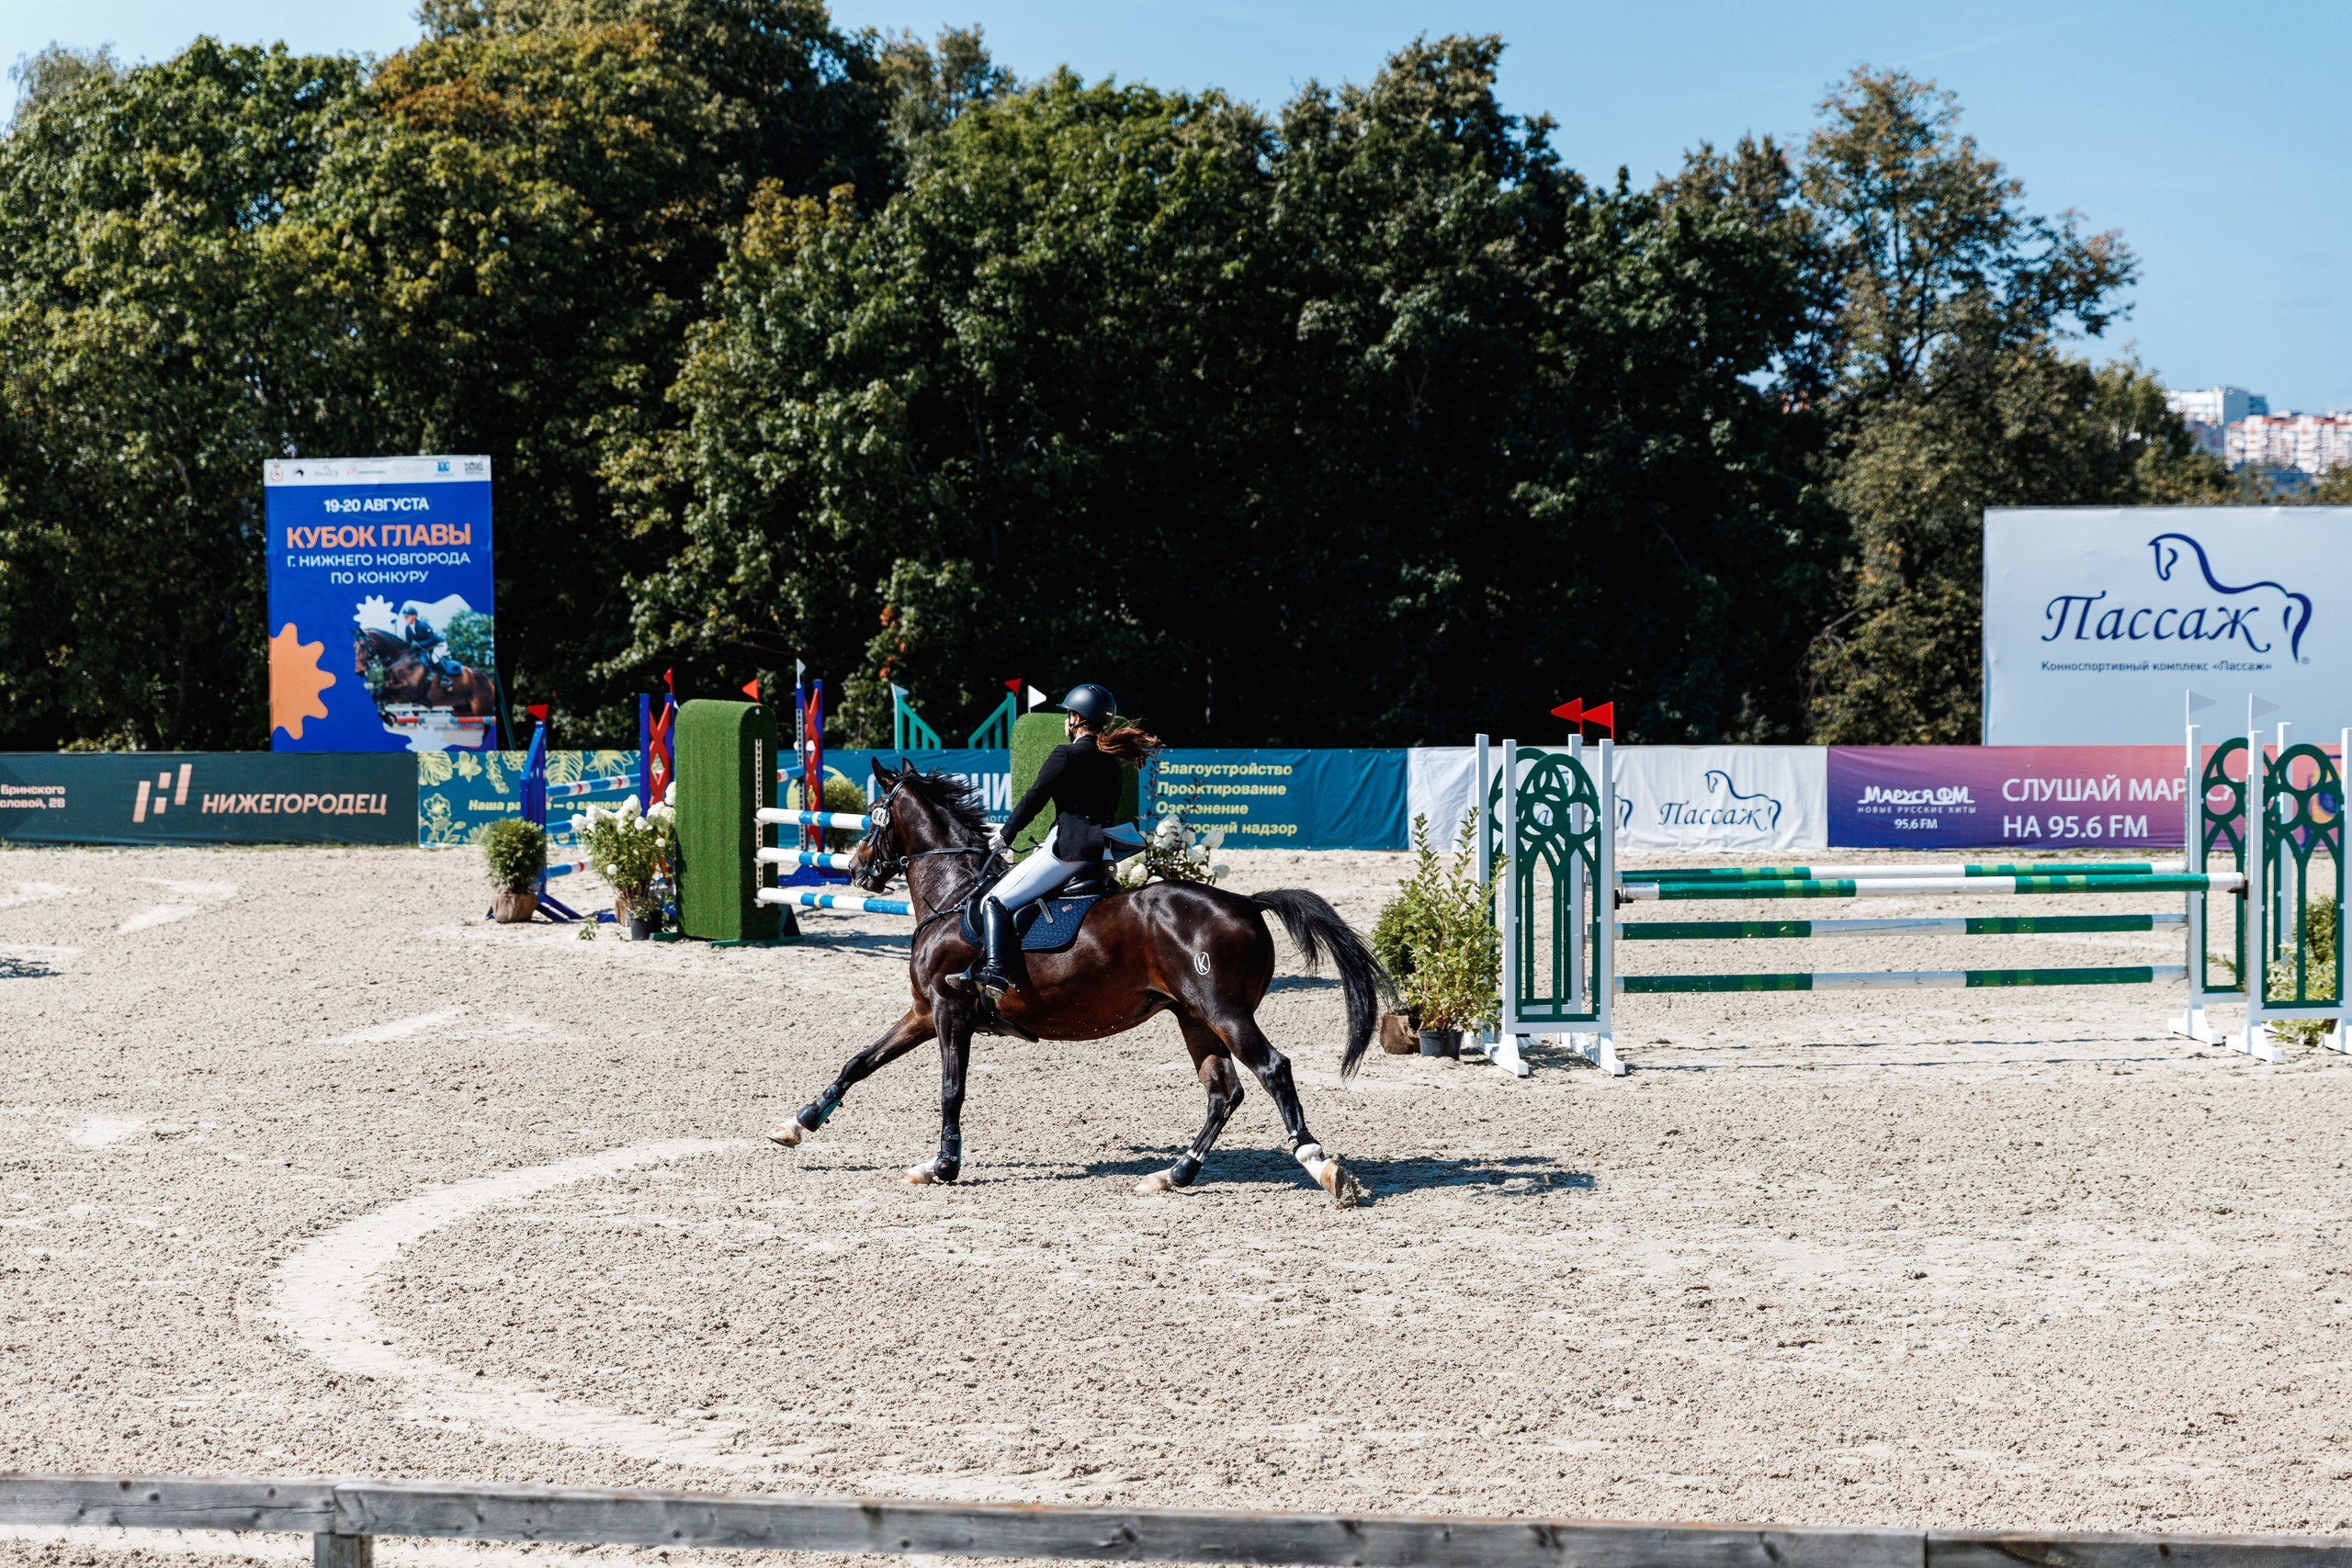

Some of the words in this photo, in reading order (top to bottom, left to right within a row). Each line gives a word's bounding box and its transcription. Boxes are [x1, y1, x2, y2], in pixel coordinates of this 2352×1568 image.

[323, 499, 361, 513] 19-20
[363, 497, 429, 512] АВГУСТА
[287, 525, 377, 548] КУБОК
[381, 523, 471, 547] ГЛАВЫ
[287, 555, 296, 567] Г.
[299, 554, 373, 567] НИЖНЕГО
[376, 552, 471, 566] НОВГОРОДА
[331, 572, 353, 584] ПО
[357, 570, 428, 584] КОНКУРУ
[2041, 590, 2272, 653] Пассаж
[2041, 660, 2150, 672] Конноспортивный
[2153, 661, 2209, 671] комплекс
[2212, 660, 2272, 671] «Пассаж»
[1159, 761, 1293, 777] Благоустройство
[1, 784, 66, 796] Бринского
[1157, 781, 1287, 797] Проектирование
[2002, 773, 2123, 803] СЛУШАЙ
[202, 794, 388, 816] НИЖЕГОРОДЕЦ
[469, 799, 505, 811] Наша
[1657, 799, 1768, 831] Пассаж
[1241, 823, 1297, 837] надзор
[1919, 818, 1939, 829] FM
[2003, 816, 2041, 839] НА
[2047, 815, 2103, 839] 95.6
[2109, 815, 2149, 839] FM
